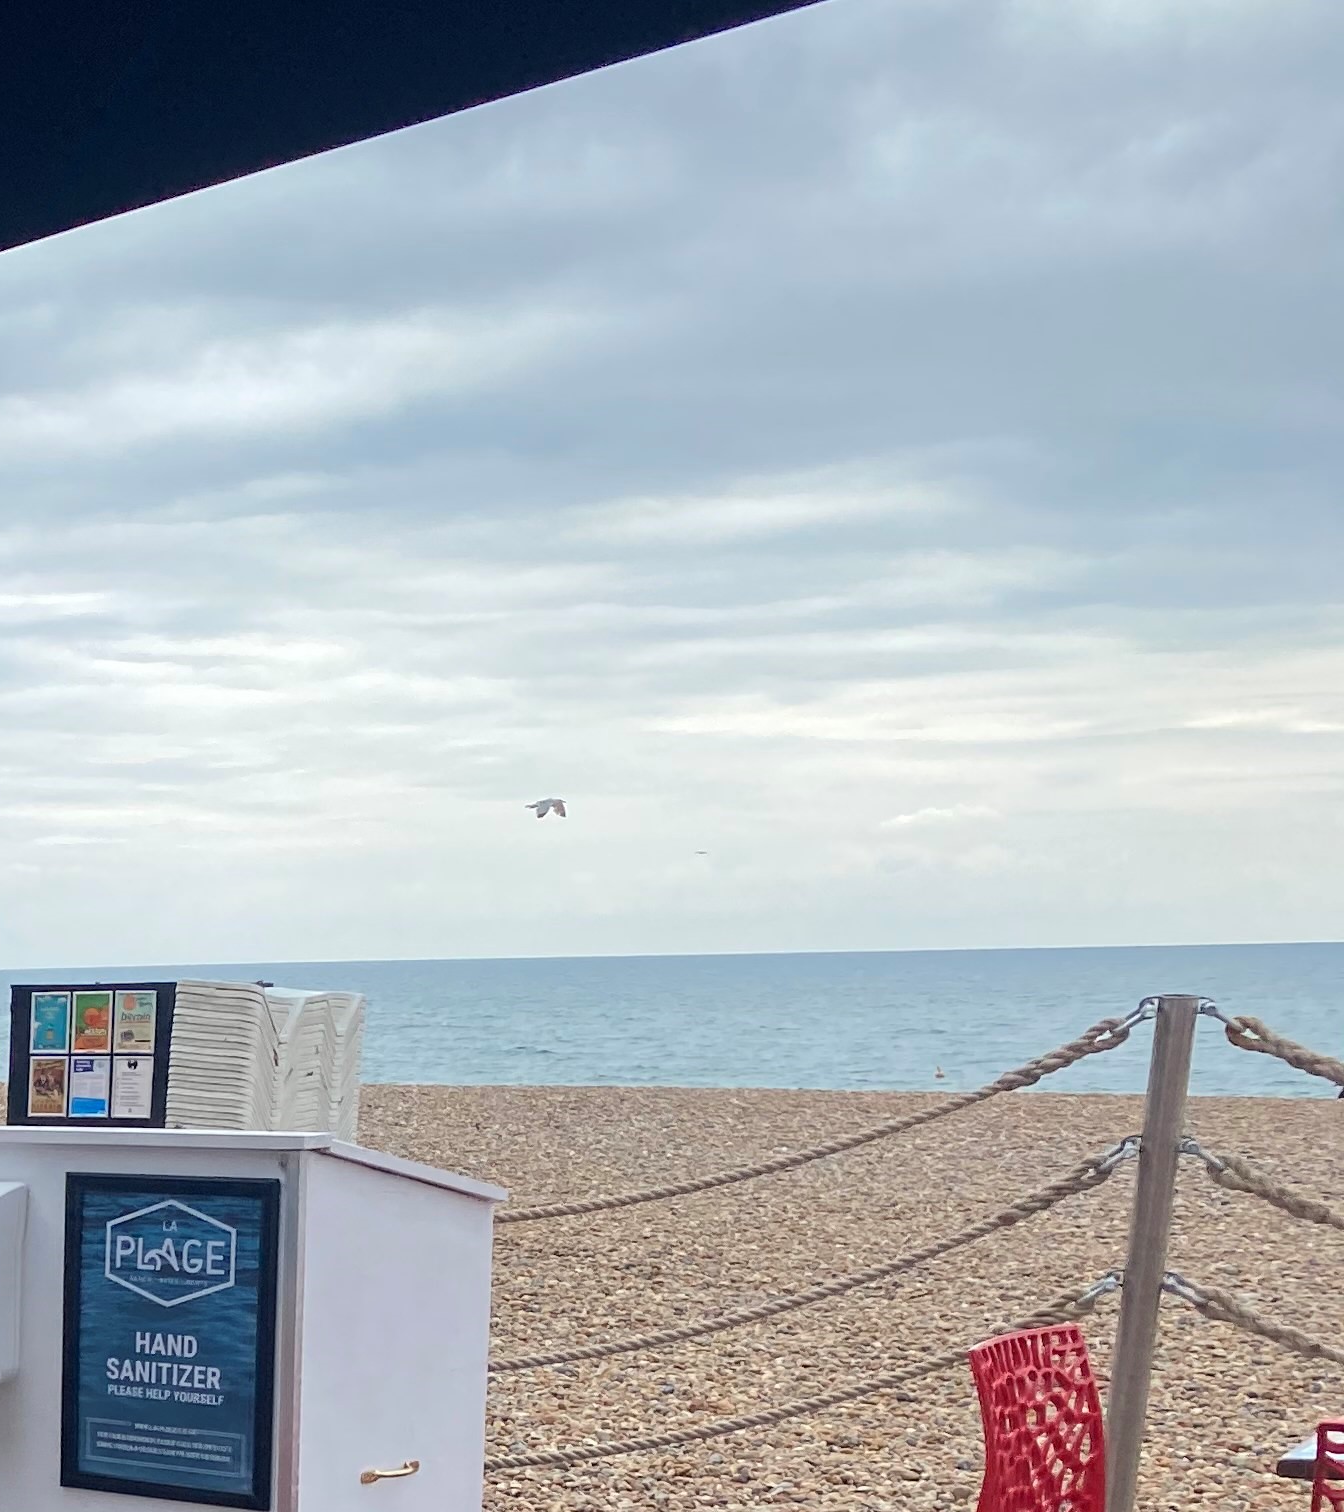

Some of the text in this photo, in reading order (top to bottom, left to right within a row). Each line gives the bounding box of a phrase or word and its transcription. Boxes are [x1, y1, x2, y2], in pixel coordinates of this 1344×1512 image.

[162, 1220, 178, 1232] LA
[115, 1235, 226, 1275] PLAGE
[135, 1331, 198, 1358] HAND
[106, 1357, 221, 1390] SANITIZER
[107, 1384, 225, 1406] PLEASE HELP YOURSELF
